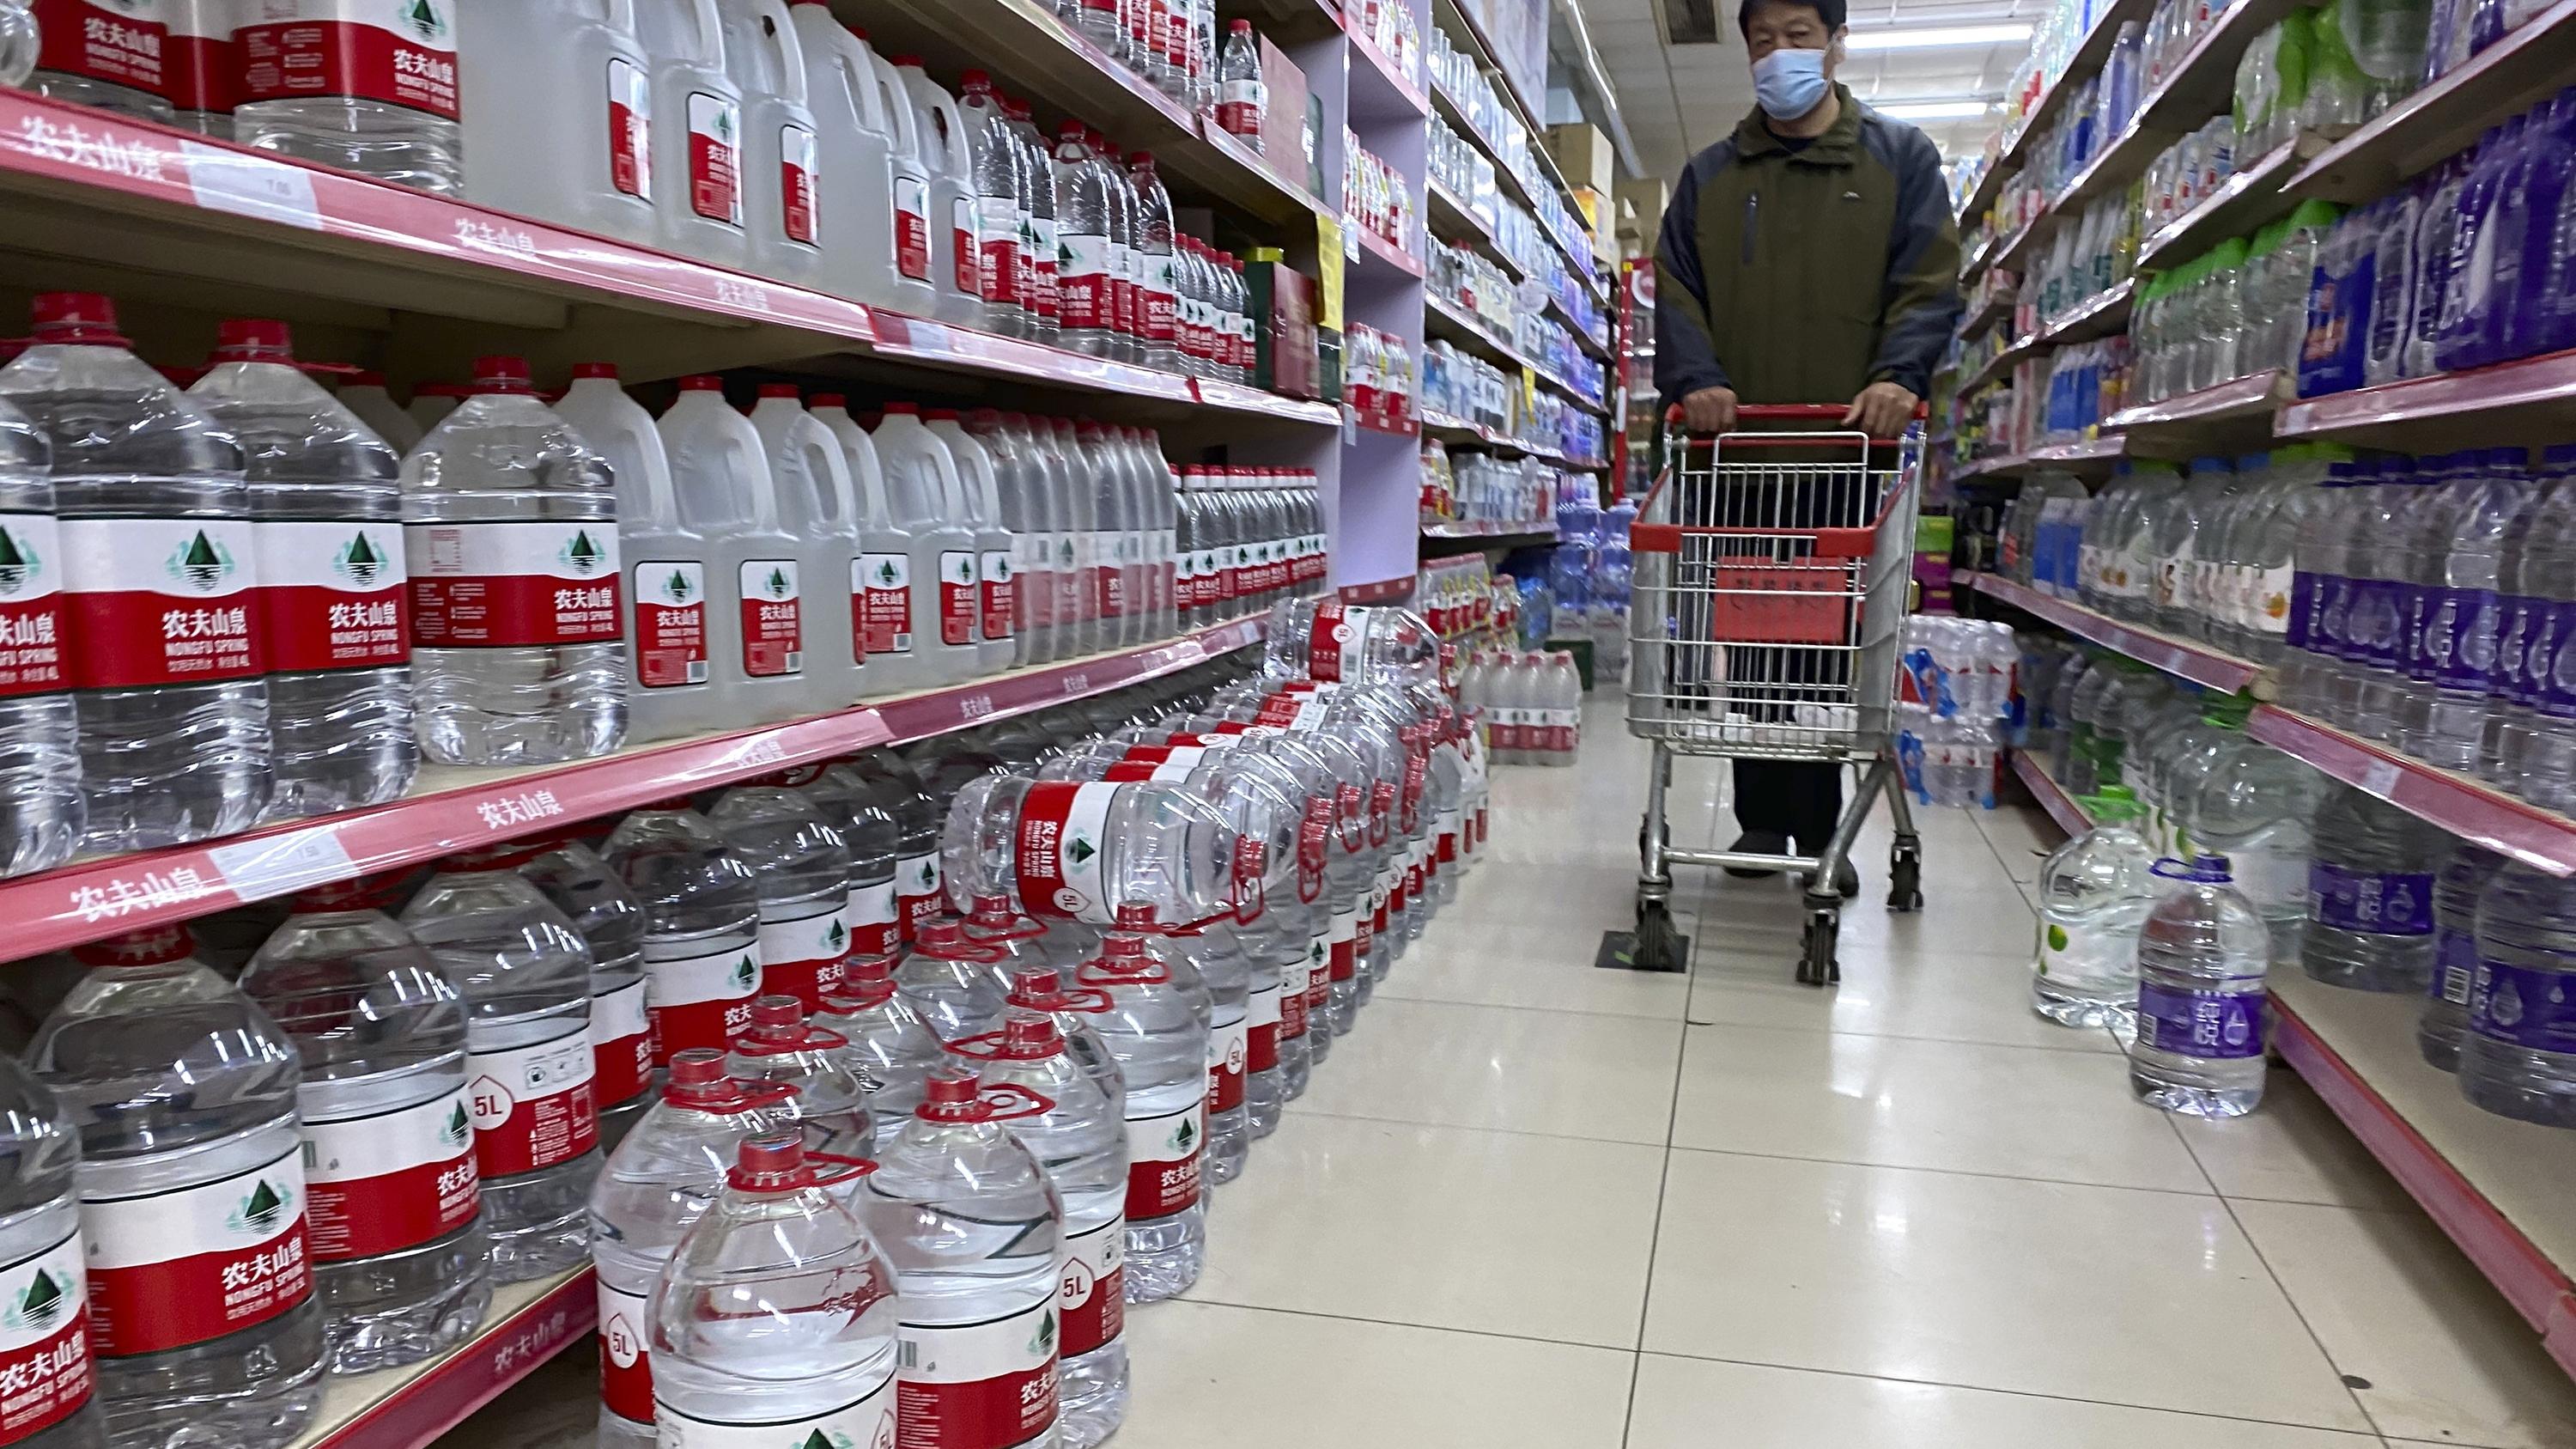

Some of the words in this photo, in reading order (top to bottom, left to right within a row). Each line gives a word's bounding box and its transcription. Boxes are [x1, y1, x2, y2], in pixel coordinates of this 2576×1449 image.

[554, 587, 613, 610] 农夫山泉
[161, 606, 247, 639] 农夫山泉
[328, 600, 398, 629] 农夫山泉
[477, 787, 564, 831] 农夫山泉
[1040, 819, 1058, 880] 农夫山泉
[70, 866, 207, 922] 农夫山泉
[1061, 894, 1079, 909] 5L
[475, 1094, 503, 1117] 5L
[221, 1233, 303, 1291] 农夫山泉
[1063, 1277, 1086, 1298] 5L
[612, 1332, 632, 1356] 5L
[0, 1330, 85, 1398] 农夫山泉
